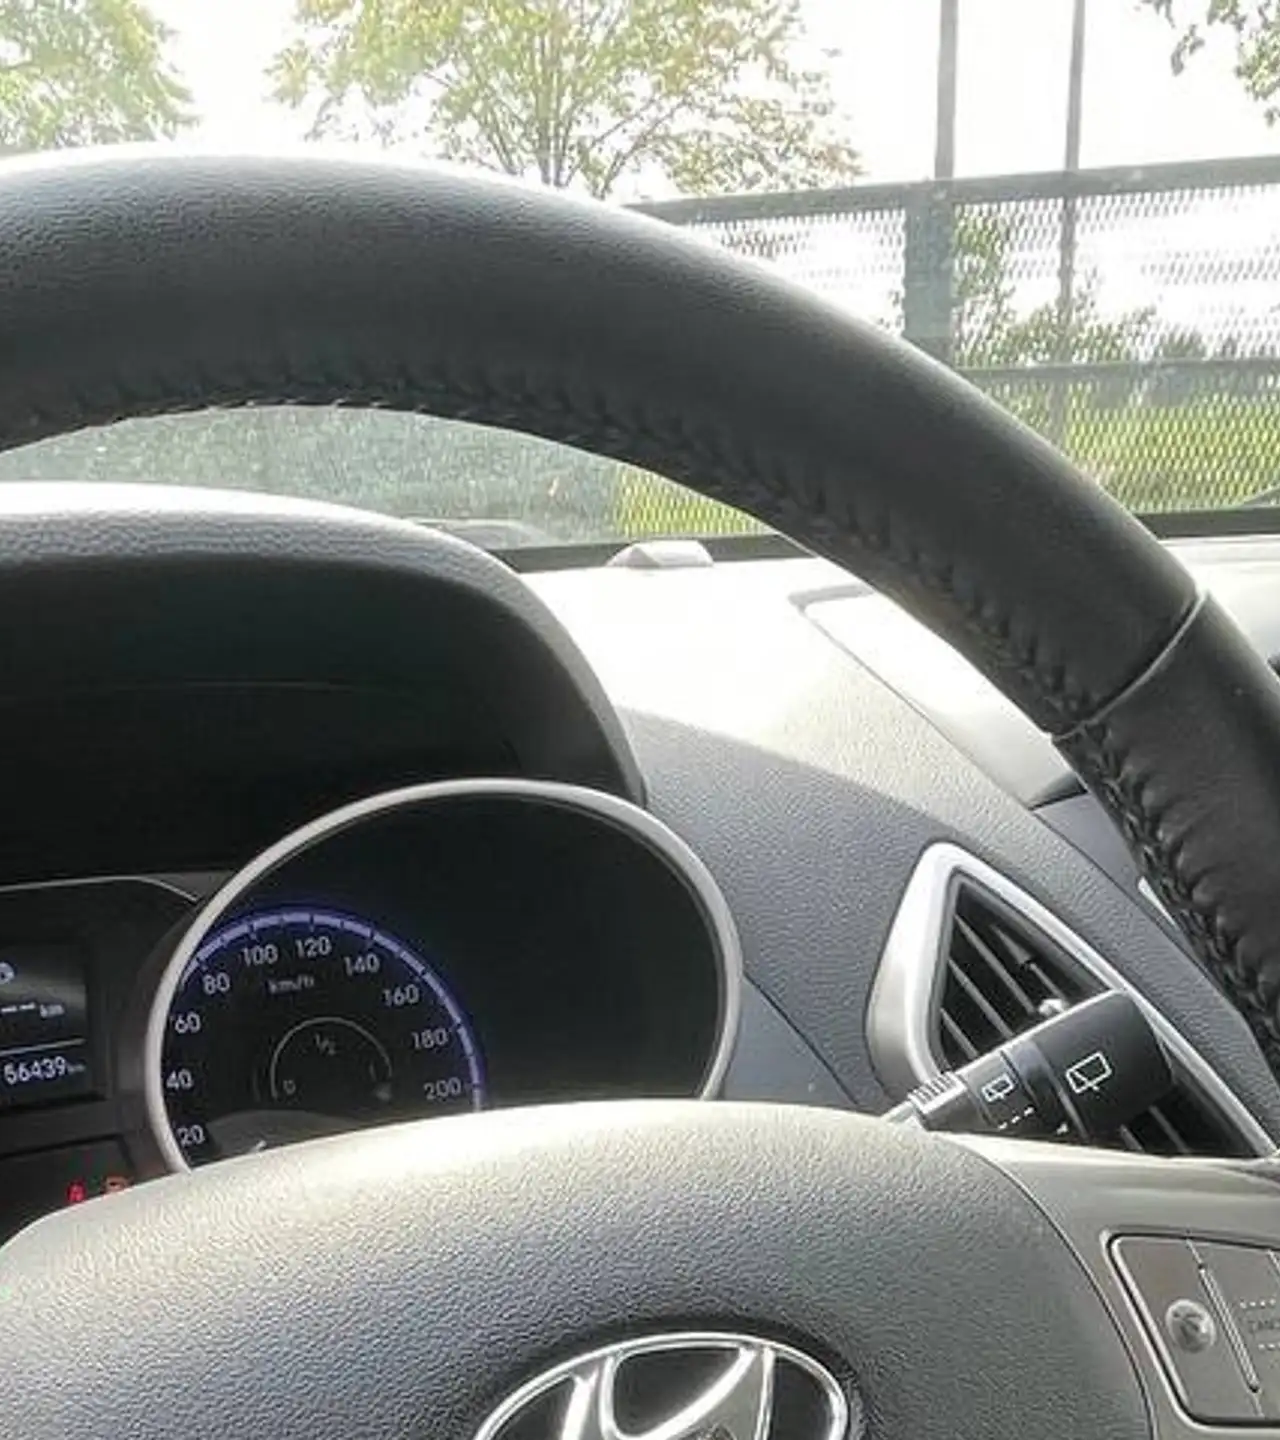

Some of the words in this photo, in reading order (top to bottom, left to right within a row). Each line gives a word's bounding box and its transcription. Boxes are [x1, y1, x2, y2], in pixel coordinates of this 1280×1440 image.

[242, 945, 278, 967] 100
[295, 936, 332, 957] 120
[343, 953, 381, 976] 140
[203, 973, 230, 995] 80
[383, 984, 419, 1007] 160
[174, 1012, 201, 1033] 60
[412, 1028, 448, 1050] 180
[166, 1069, 193, 1091] 40
[424, 1077, 462, 1100] 200
[178, 1124, 206, 1147] 20
